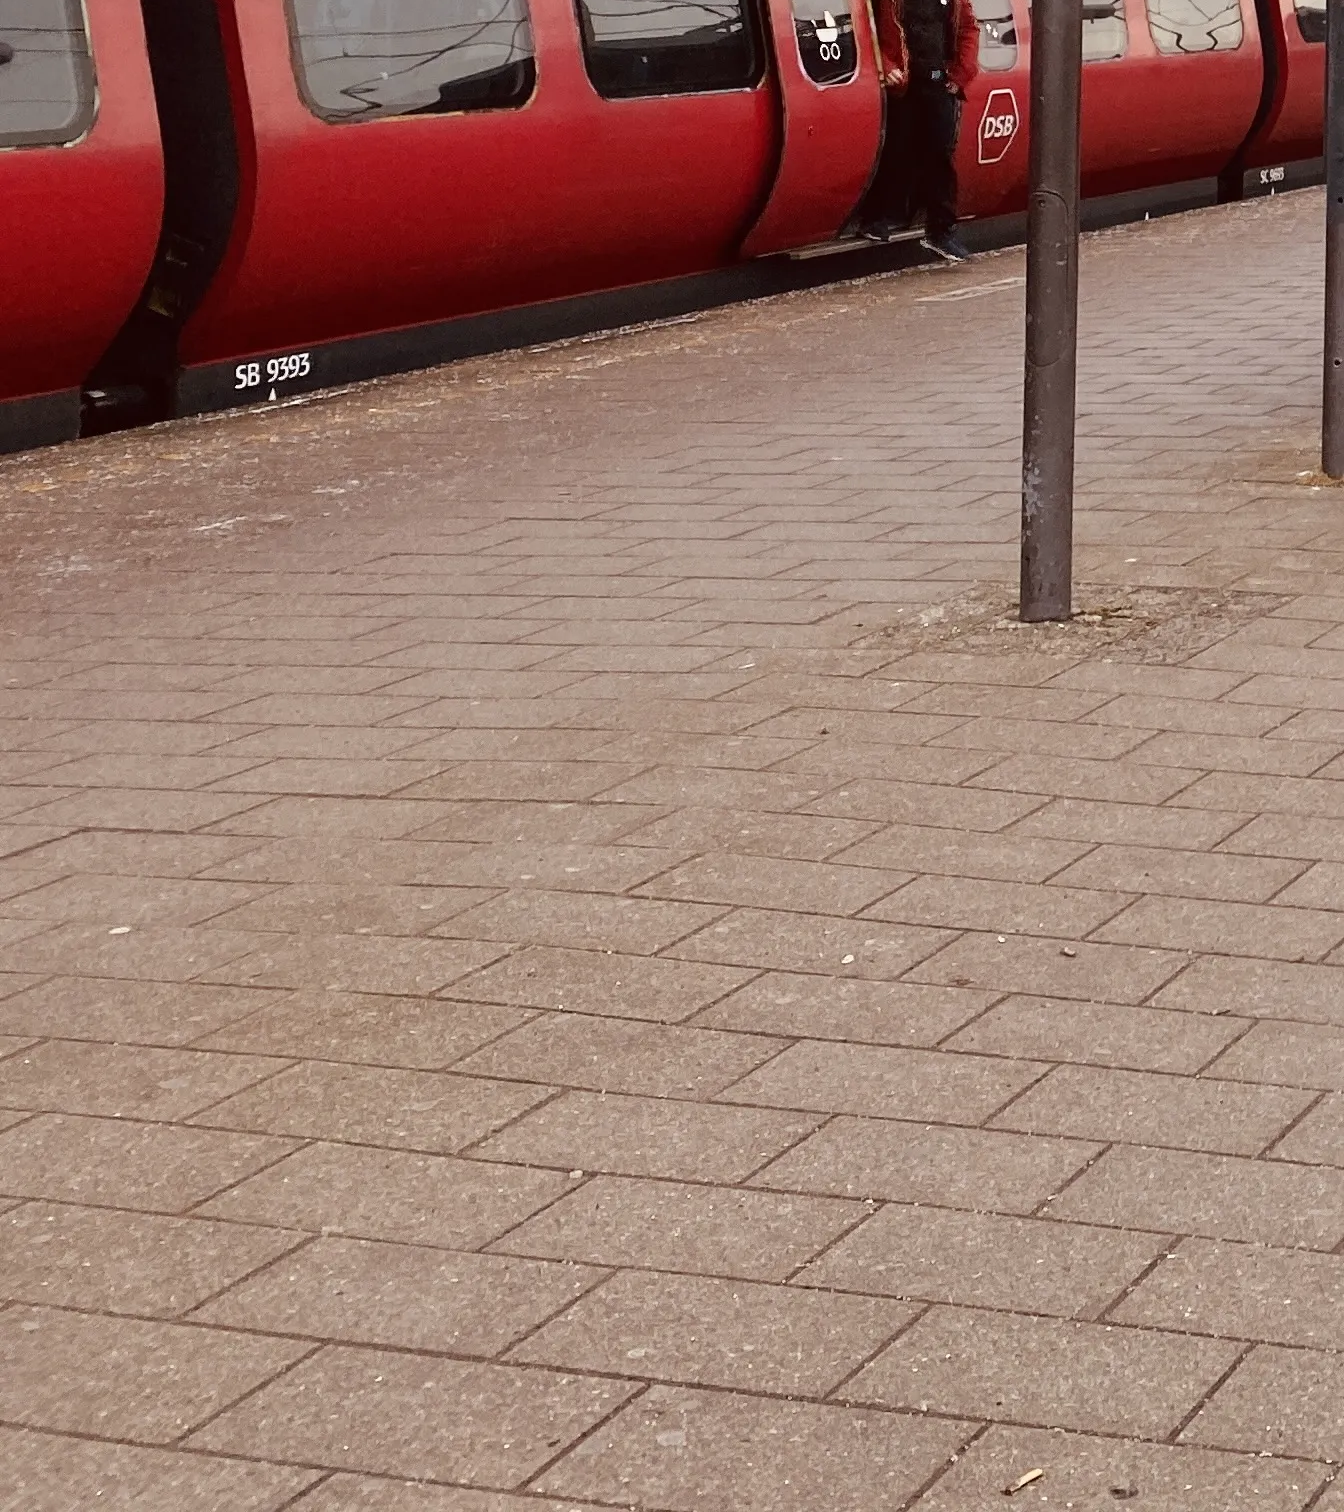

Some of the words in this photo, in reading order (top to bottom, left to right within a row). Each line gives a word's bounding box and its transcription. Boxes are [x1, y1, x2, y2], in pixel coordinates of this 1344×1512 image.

[984, 114, 1014, 139] DSB
[234, 362, 261, 390] SB
[266, 352, 311, 384] 9393
